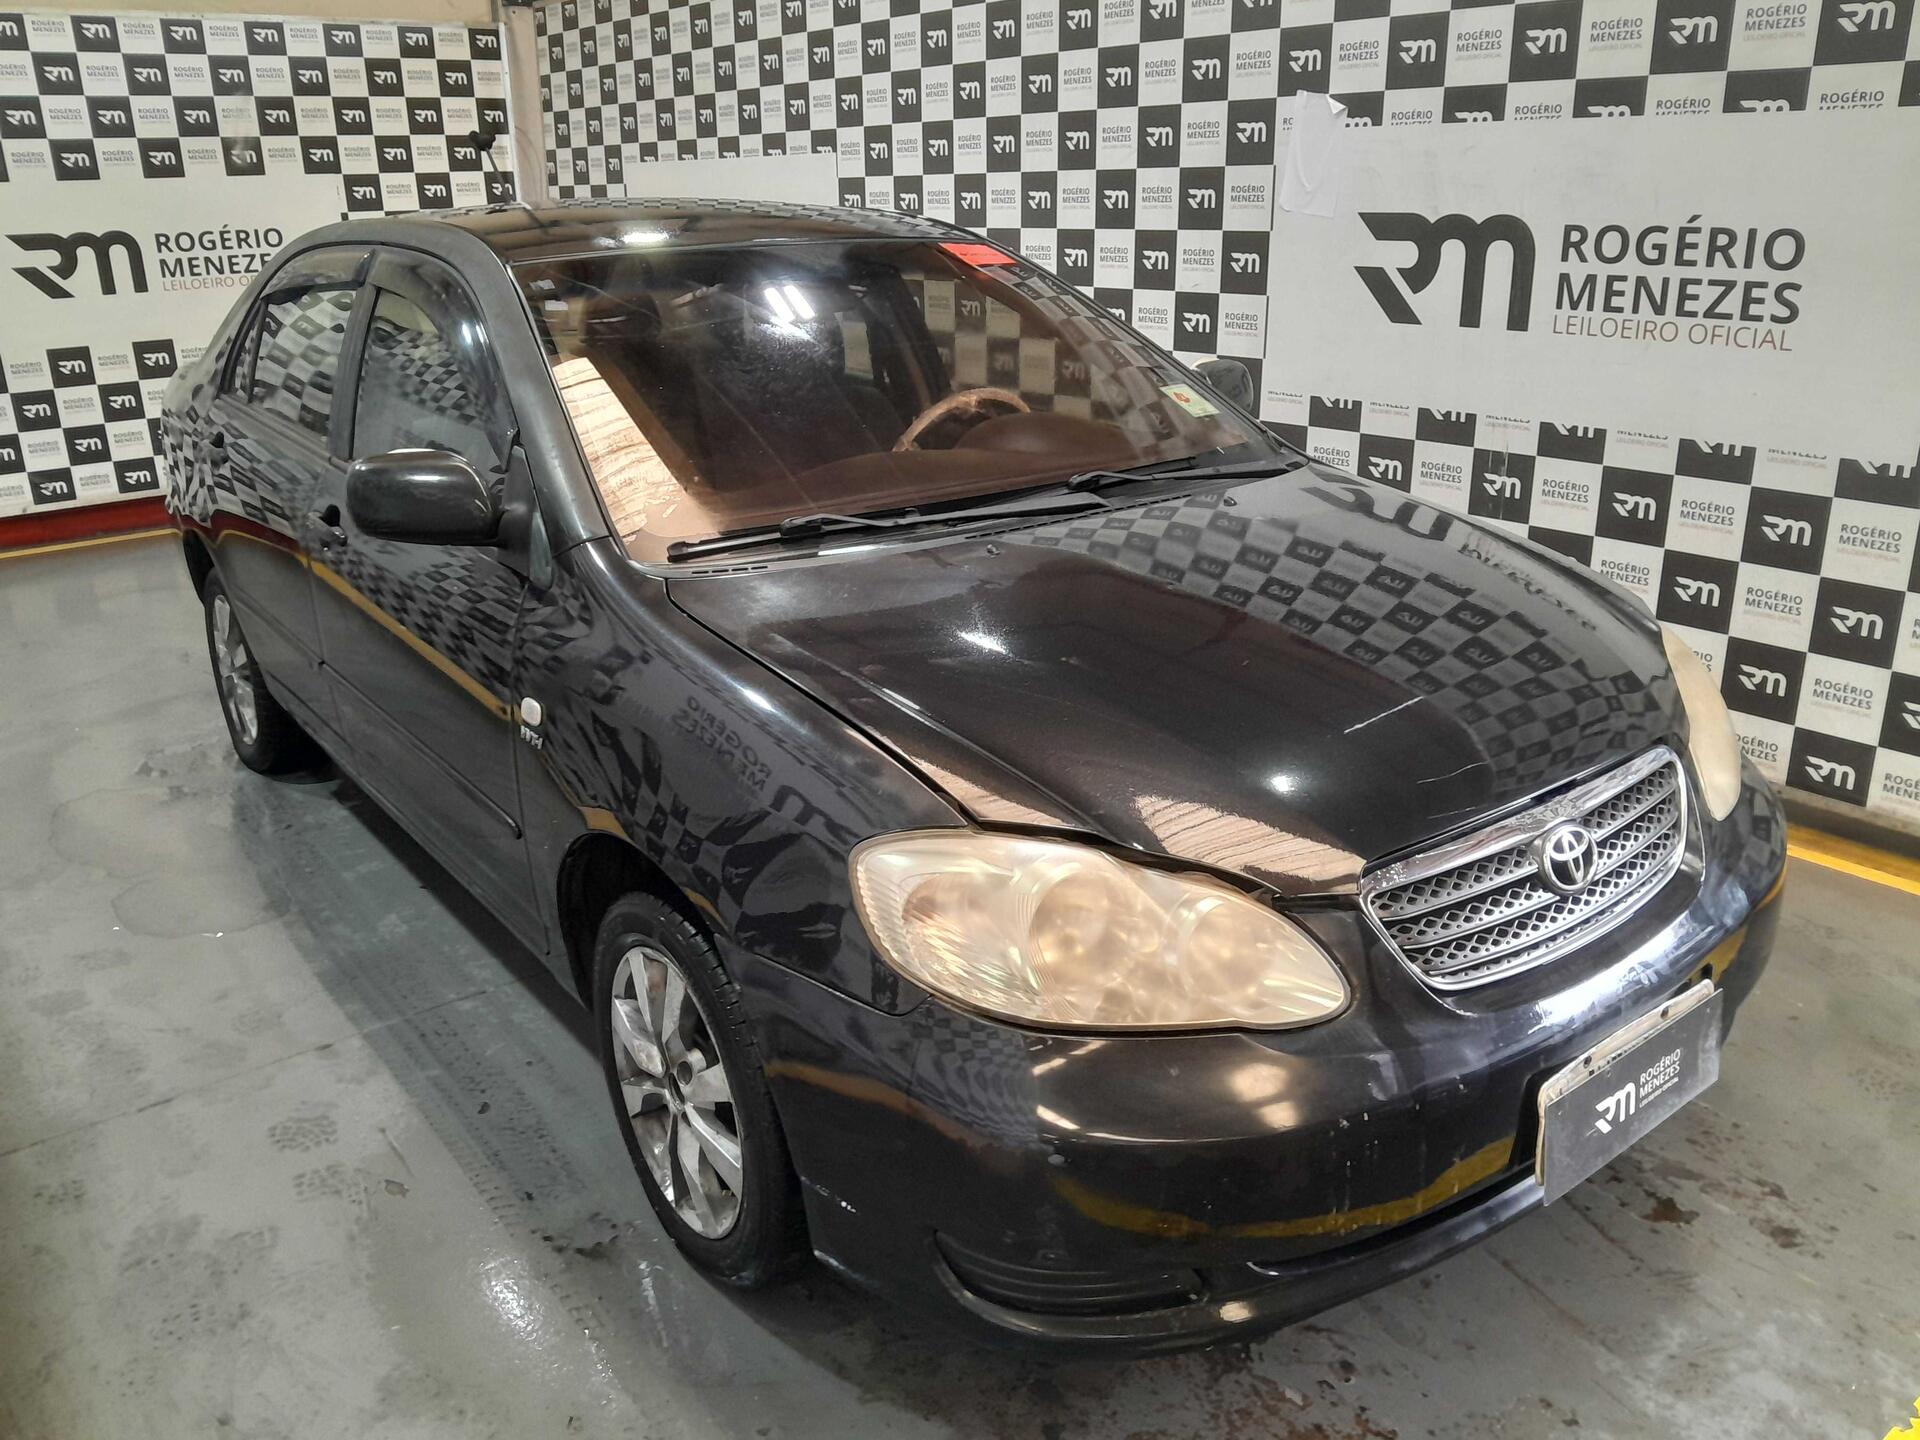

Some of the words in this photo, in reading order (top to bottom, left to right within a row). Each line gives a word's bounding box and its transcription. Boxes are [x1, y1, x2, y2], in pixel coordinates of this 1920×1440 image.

[1746, 4, 1807, 19] ROGÉRIO
[1591, 17, 1643, 31] ROGÉRIO
[1745, 16, 1805, 31] MENEZES
[1457, 29, 1502, 42] ROGÉRIO
[1590, 29, 1642, 42] MENEZES
[1340, 40, 1379, 52] ROGÉRIO
[1456, 40, 1502, 52] MENEZES
[1236, 50, 1271, 61] ROGÉRIO
[1339, 50, 1378, 62] MENEZES
[1236, 60, 1271, 70] MENEZES
[1656, 96, 1711, 110] ROGÉRIO
[1820, 88, 1884, 104] ROGÉRIO
[1391, 109, 1433, 121] ROGÉRIO
[1513, 102, 1562, 115] ROGÉRIO
[1187, 120, 1220, 130] ROGÉRIO
[1187, 130, 1220, 139] MENEZES
[1231, 184, 1265, 193] ROGÉRIO
[1230, 194, 1264, 202] MENEZES
[155, 224, 283, 253] ROGÉRIO
[1561, 215, 1805, 271] ROGÉRIO
[159, 253, 272, 278] MENEZE
[163, 276, 234, 292] LEILOEIRO
[1556, 273, 1802, 324] MENEZES
[1225, 312, 1258, 322] ROGÉRIO
[1225, 321, 1258, 330] MENEZES
[1553, 314, 1678, 342] LEILOEIRO
[1688, 323, 1792, 351] OFICIAL
[1314, 446, 1350, 458] ROGÉRIO
[1421, 461, 1462, 474] ROGÉRIO
[1420, 470, 1462, 484] MENEZES
[1543, 479, 1589, 493] ROGÉRIO
[1542, 488, 1588, 503] MENEZES
[1682, 500, 1734, 515] ROGÉRIO
[1680, 510, 1733, 526] MENEZES
[1841, 524, 1902, 542] ROGÉRIO
[1839, 535, 1900, 553] MENEZES
[1601, 560, 1650, 576] ROGÉRIO
[1747, 587, 1802, 605] ROGÉRIO
[1745, 598, 1801, 616] MENEZES
[1814, 678, 1873, 699] ROGÉRIO
[1813, 688, 1872, 710] MENEZES
[1640, 1048, 1680, 1085] ROGÉRIO
[1640, 1061, 1680, 1098] MENEZES
